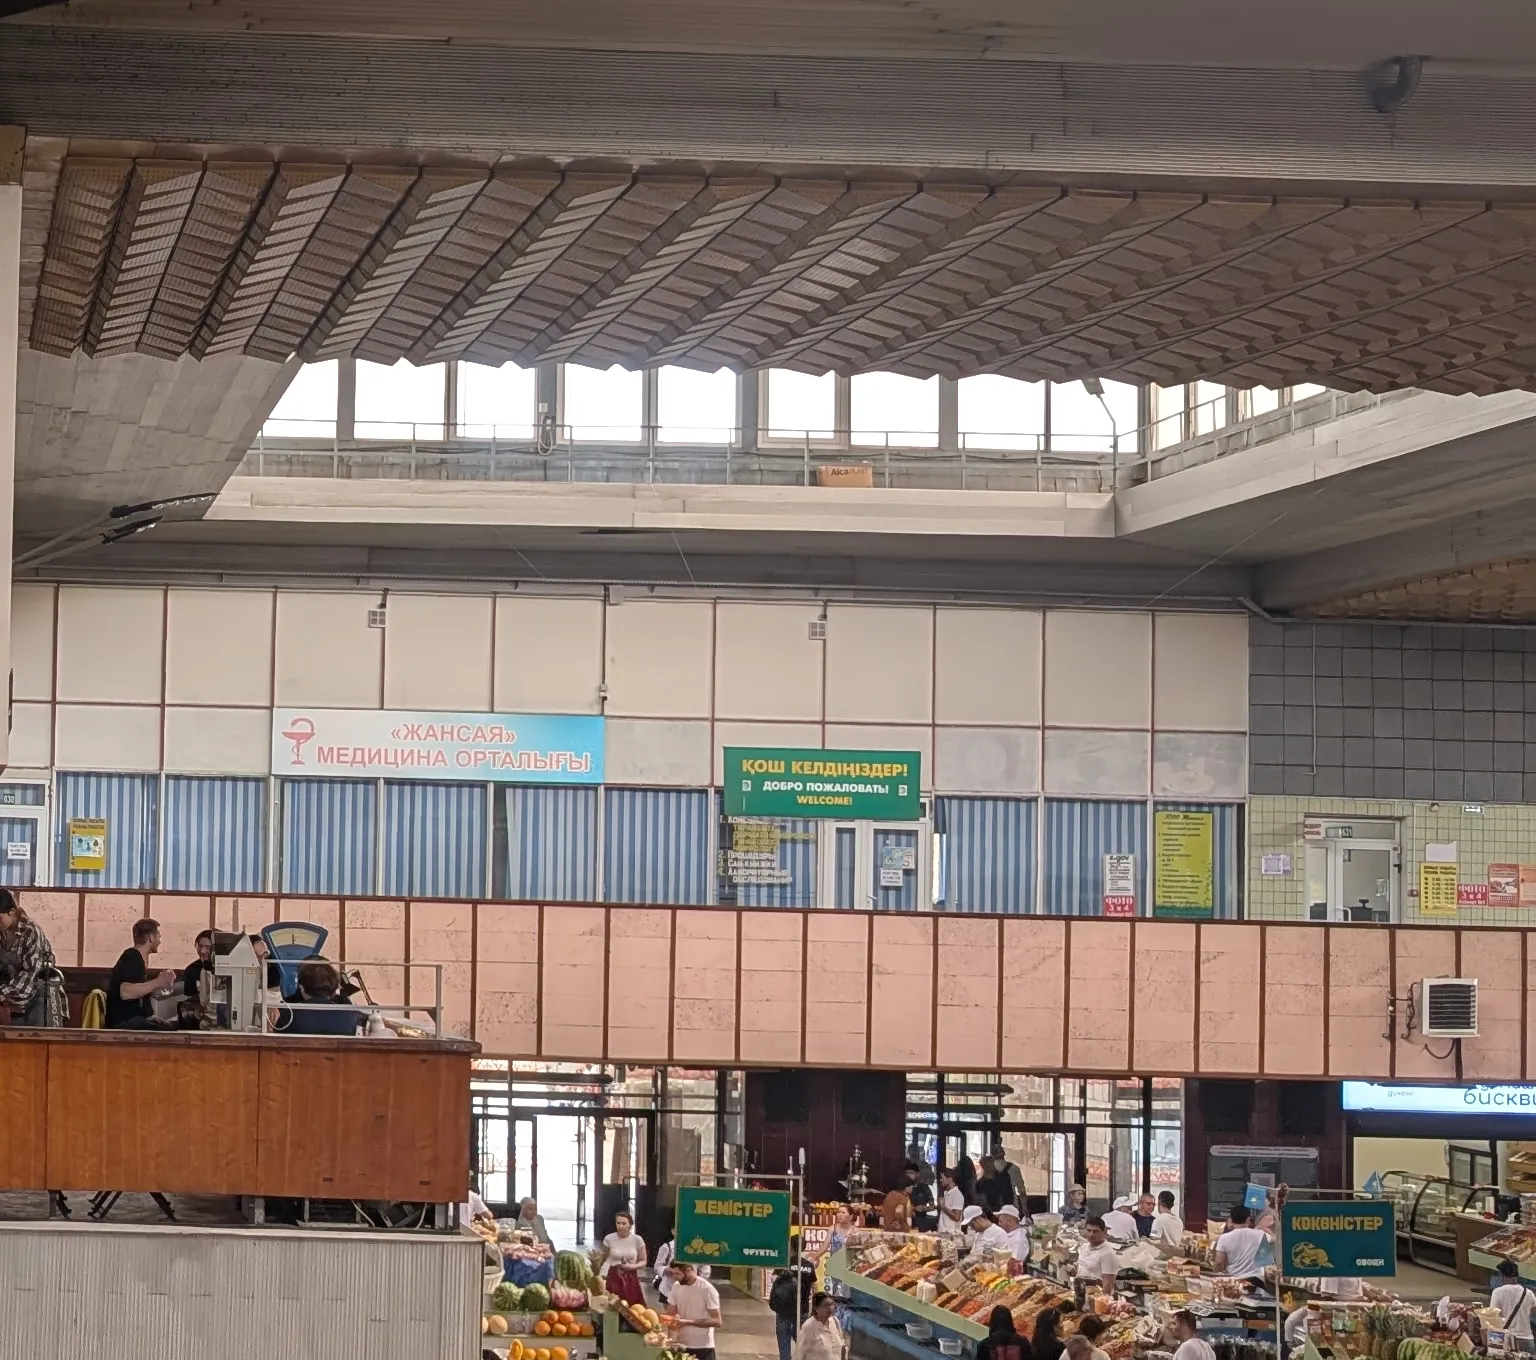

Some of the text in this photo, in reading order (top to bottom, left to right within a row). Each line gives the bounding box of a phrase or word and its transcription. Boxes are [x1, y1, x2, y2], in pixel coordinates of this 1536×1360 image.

[390, 723, 516, 745] «ЖАНСАЯ»
[317, 745, 590, 773] МЕДИЦИНА ОРТАЛЫҒЫ
[742, 759, 785, 775] ҚОШ
[762, 781, 889, 794] ДОБРО ПОЖАЛОВАТЬ!
[796, 795, 853, 806] WELCOME!
[694, 1200, 773, 1217] ЖЕМІСТЕР
[743, 1248, 779, 1257] ФРУКТЫ
